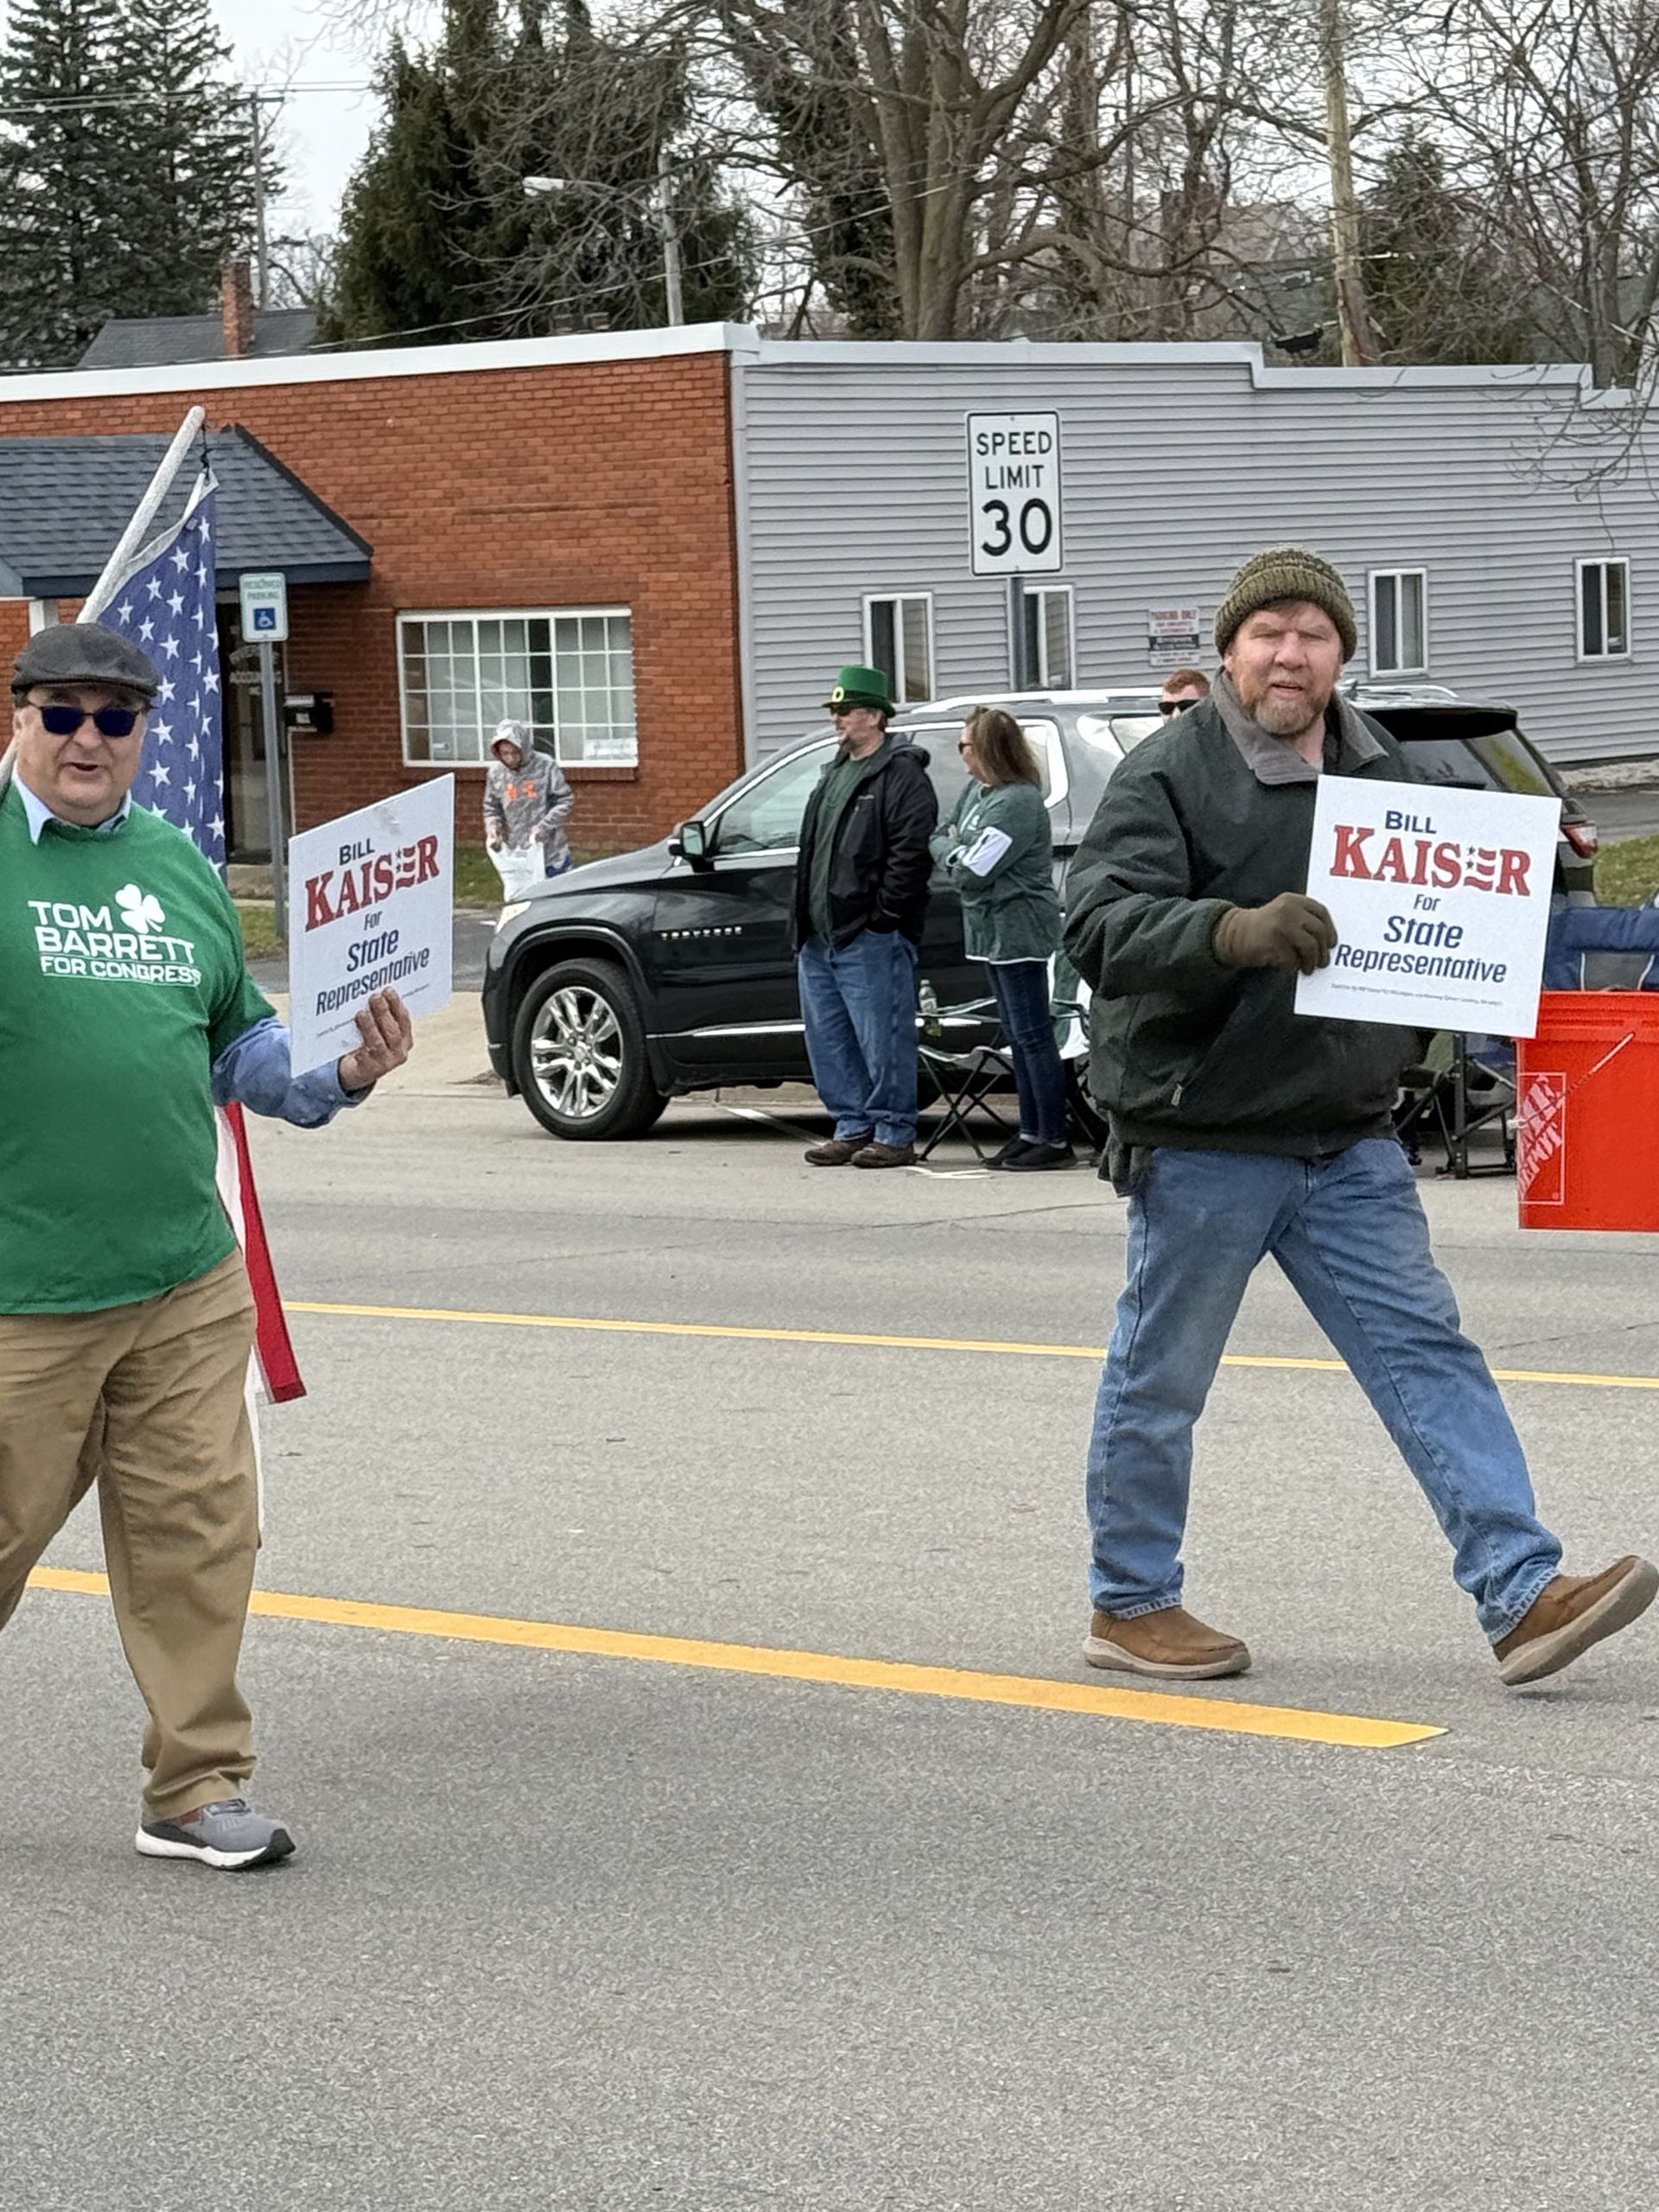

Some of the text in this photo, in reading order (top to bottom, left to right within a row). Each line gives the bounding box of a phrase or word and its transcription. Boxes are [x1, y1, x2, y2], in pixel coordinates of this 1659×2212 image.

[976, 431, 1052, 456] SPEED
[985, 465, 1045, 489] LIMIT
[981, 498, 1052, 556] 30
[1385, 810, 1437, 834] BILL
[340, 838, 375, 865] BILL
[1330, 824, 1531, 896] KAISER
[305, 835, 440, 932] KAISER
[28, 900, 113, 931] TOM
[1414, 894, 1441, 911] For
[364, 911, 383, 931] For
[1383, 915, 1464, 949] State
[35, 926, 194, 964] BARRETT
[346, 929, 399, 972] State
[40, 956, 201, 987] FOR CONGRESS
[1334, 944, 1507, 983] Representative
[315, 947, 429, 1016] Representative
